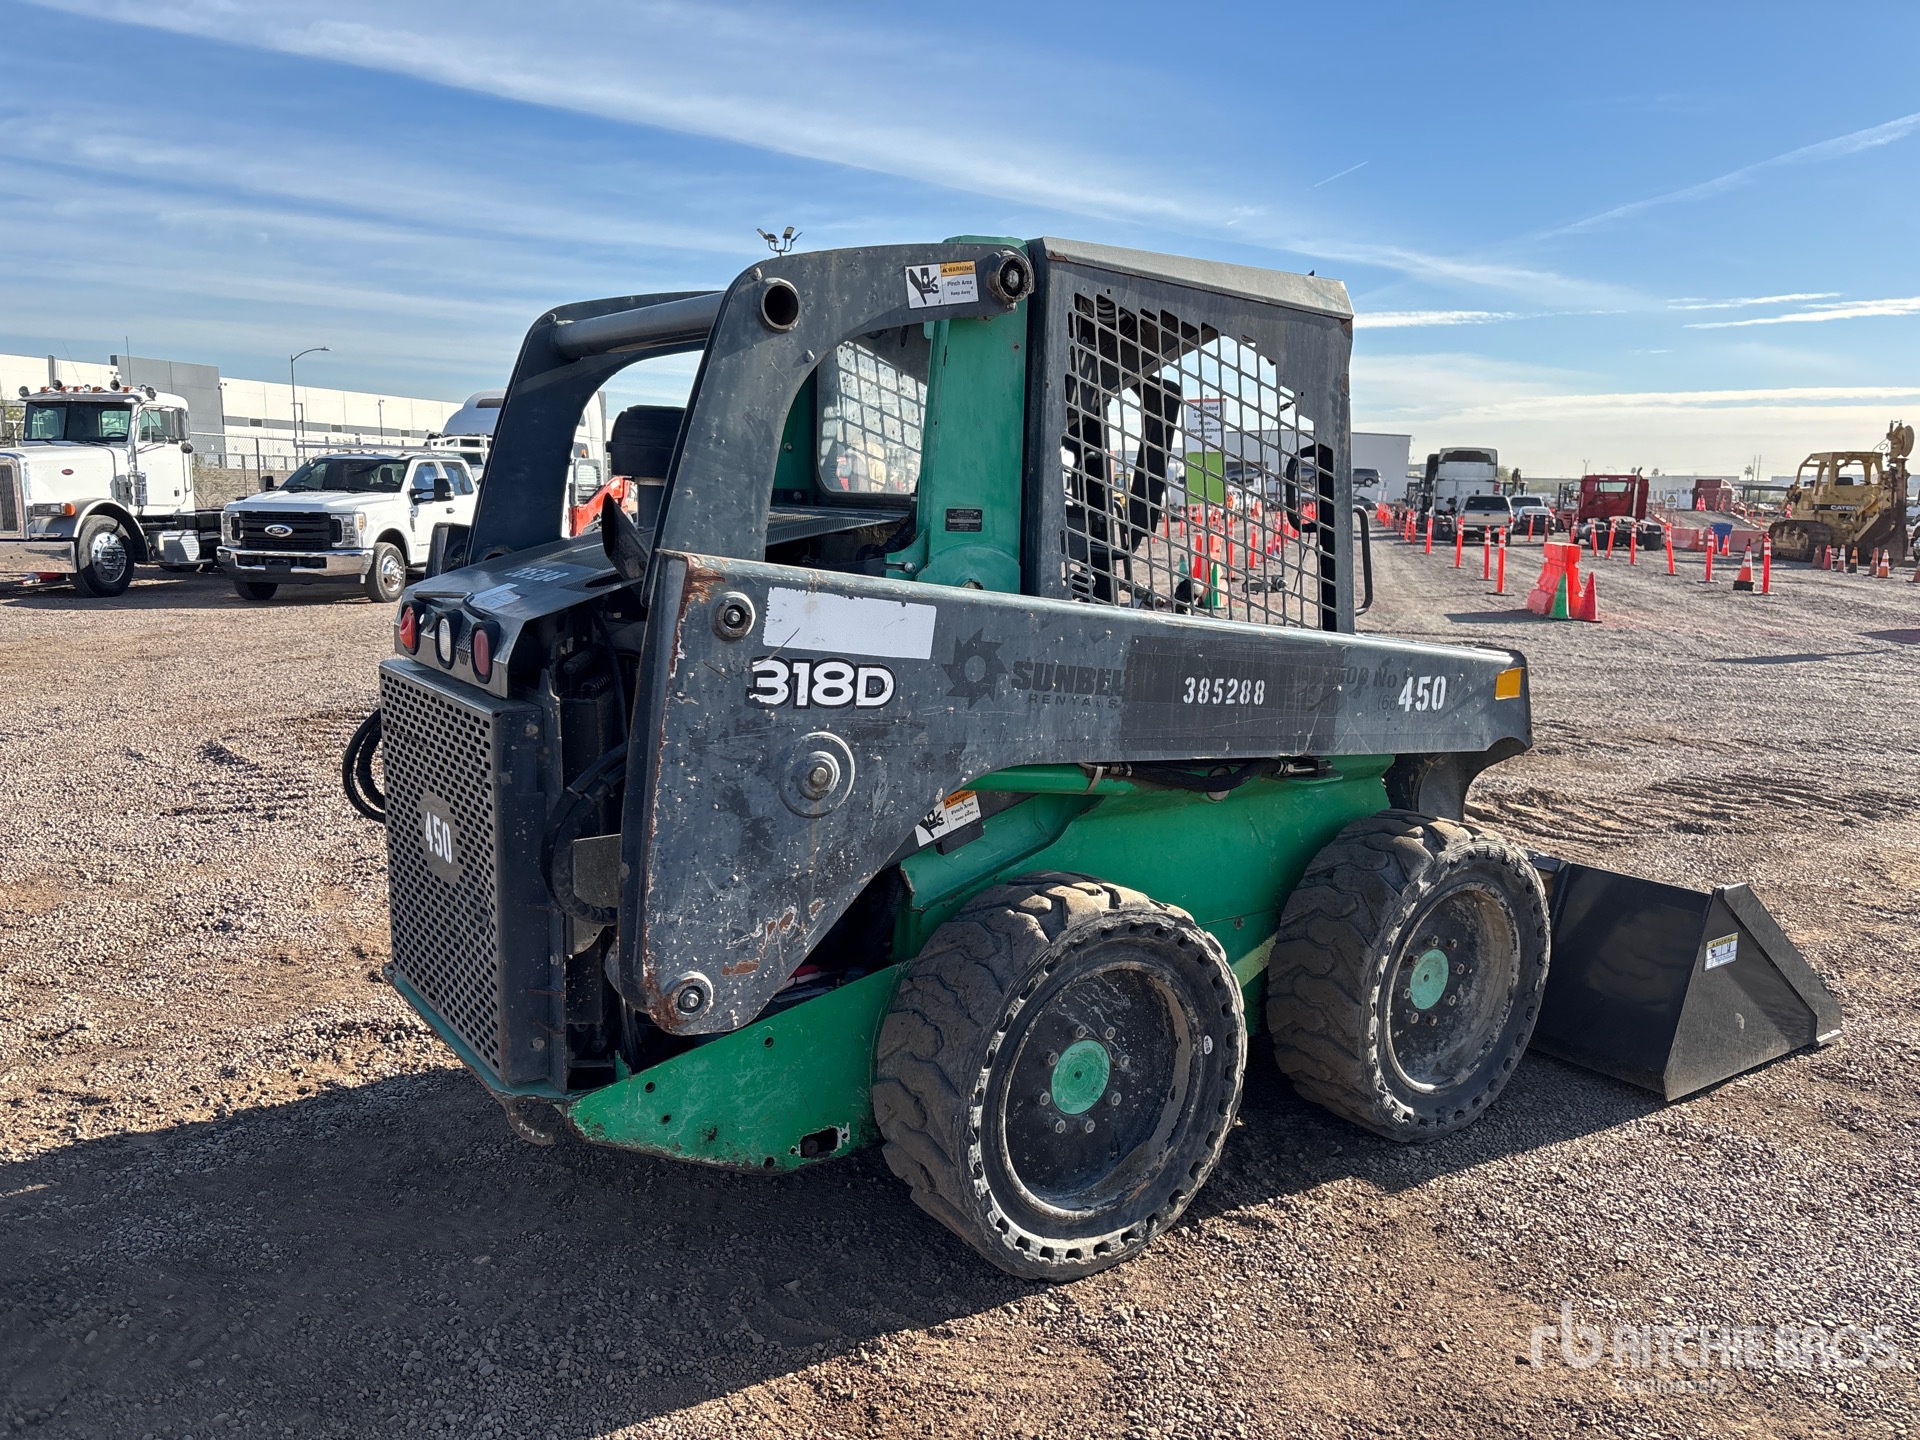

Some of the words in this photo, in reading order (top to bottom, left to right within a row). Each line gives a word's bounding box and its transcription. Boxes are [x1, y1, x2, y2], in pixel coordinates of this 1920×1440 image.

[948, 265, 973, 273] WARNING
[747, 657, 895, 708] 318D
[1010, 660, 1125, 697] SUNBEL
[1183, 677, 1265, 705] 385288
[1398, 675, 1446, 712] 450
[1028, 693, 1121, 709] RENTALS
[426, 811, 452, 864] 450
